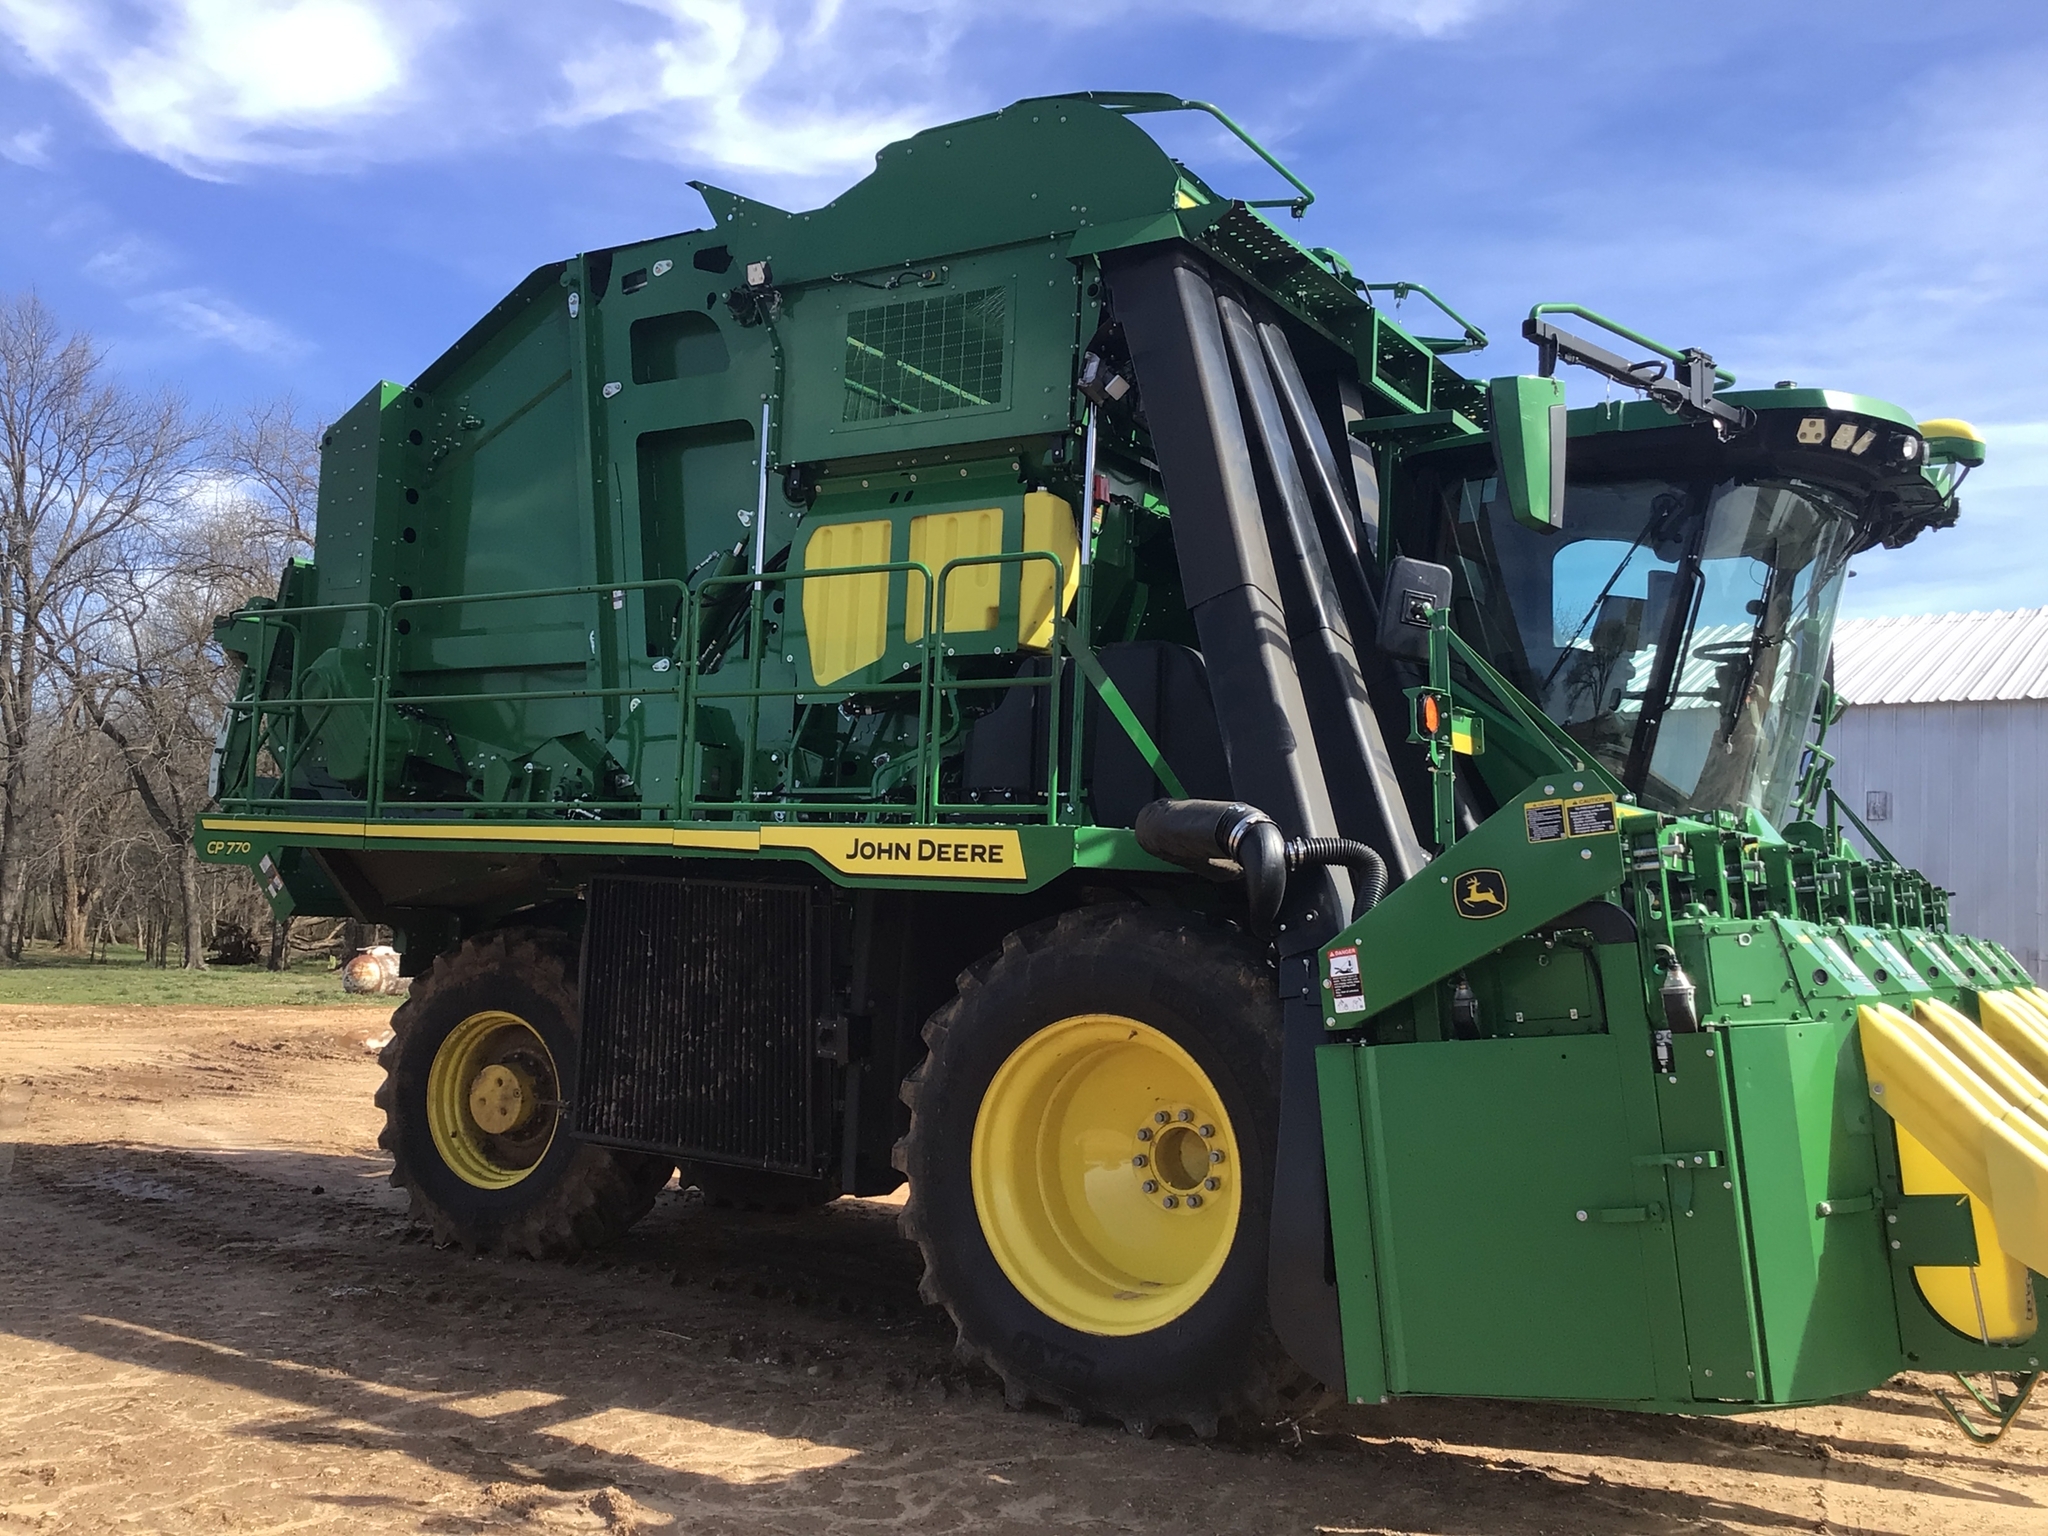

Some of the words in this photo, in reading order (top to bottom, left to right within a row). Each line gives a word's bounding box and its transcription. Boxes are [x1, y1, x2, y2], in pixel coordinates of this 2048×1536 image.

[207, 841, 224, 854] CP
[226, 842, 251, 854] 770
[846, 838, 911, 860] JOHN
[917, 839, 1004, 863] DEERE
[1335, 948, 1356, 956] DANGER
